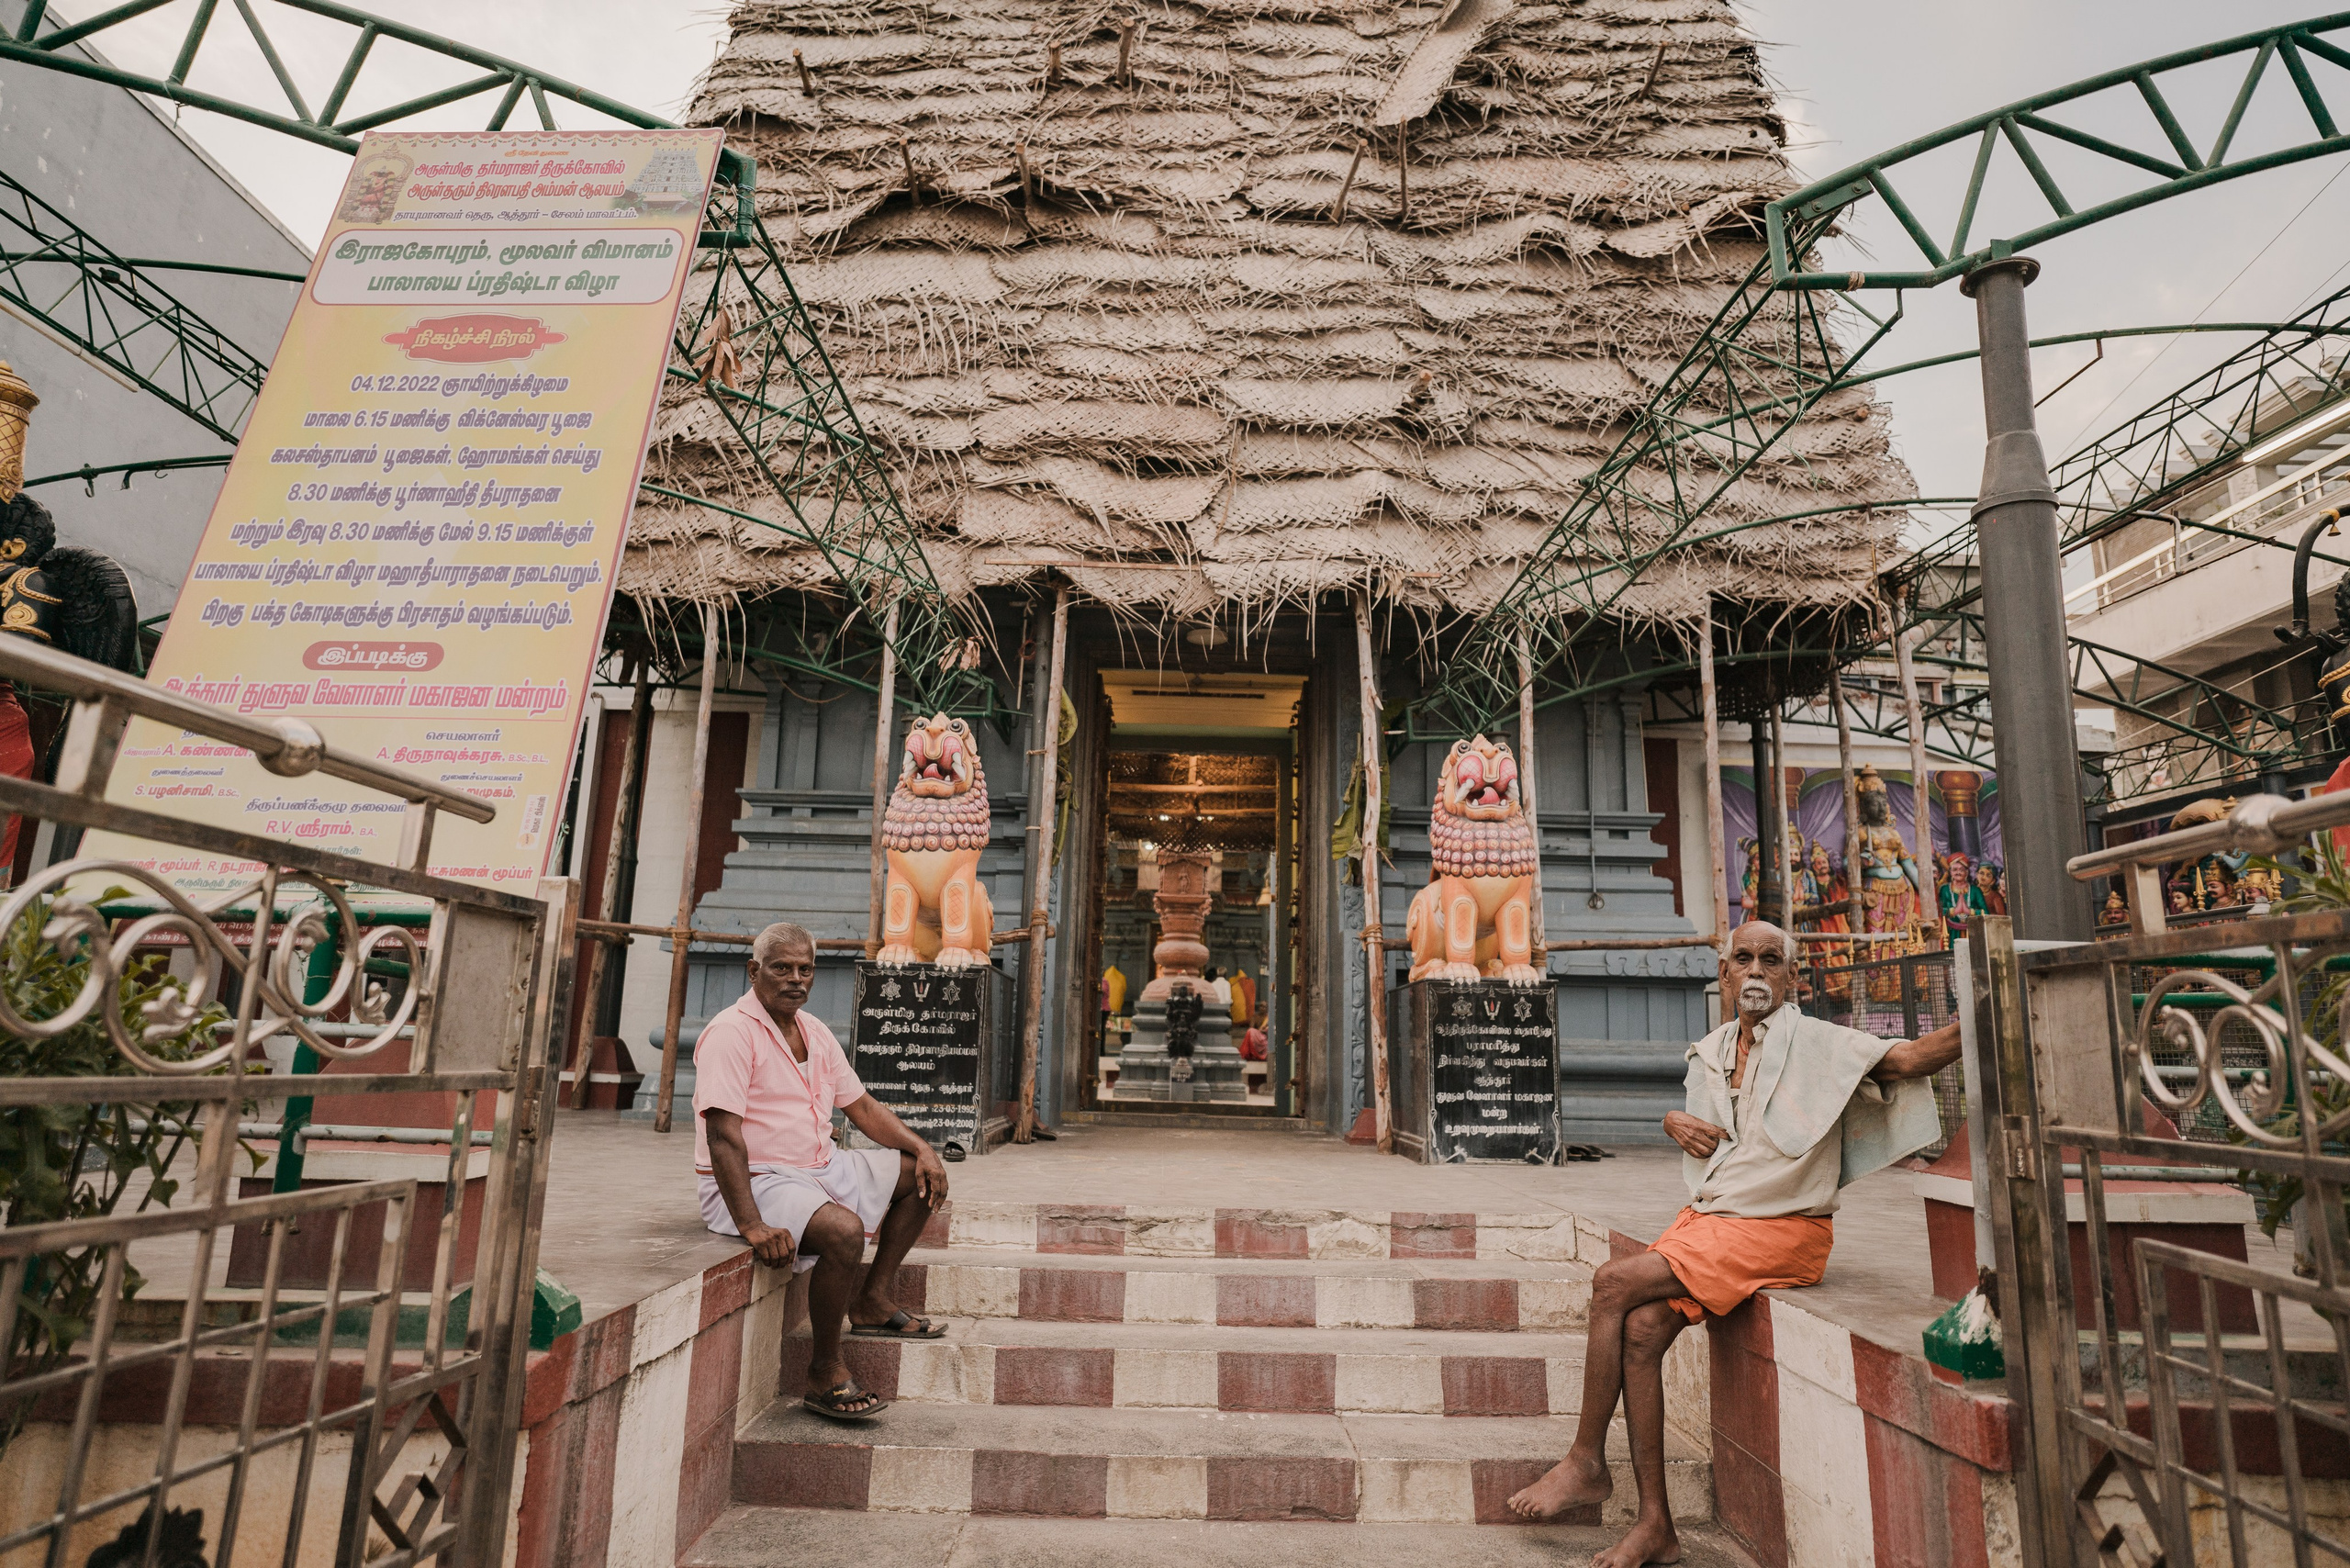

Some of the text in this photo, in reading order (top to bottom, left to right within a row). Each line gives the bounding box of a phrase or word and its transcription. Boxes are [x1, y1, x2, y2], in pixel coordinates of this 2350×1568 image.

[415, 159, 626, 178] அருள்மிகு தர்மராஜர் திருக்கோவில்
[407, 181, 475, 200] அருள்தரும்
[532, 182, 576, 200] அம்மன்
[578, 181, 625, 200] ஆலயம்
[394, 209, 462, 221] தாயுமானவர்
[465, 210, 494, 221] தெரு,
[498, 209, 540, 221] ஆத்தூர்
[551, 209, 583, 219] சேலம்
[586, 208, 637, 218] மாவட்டம்.
[335, 237, 673, 265] இராஜகோபுரம், மூலவர் விமானம்
[367, 270, 620, 297] பாலாலய ப்ரதிஷ்டா விழா
[413, 327, 536, 350] நிகழ்ச்சி நிரல்
[351, 374, 568, 398] 04.12.2022 ஞாயிற்றுக்கிழமை
[304, 409, 592, 435] மாலை 6.15 மணிக்கு விக்னேஸ்வர பூஜை
[271, 443, 601, 472] கலசஸ்தாபனம் பூஜைகள், ஹோமங்கள் செய்து
[287, 484, 327, 500] 8.30
[330, 481, 390, 504] மணிக்கு
[479, 479, 561, 508] தீபராதனை
[230, 519, 593, 547] மற்றும் இரவு 8.30 மணிக்கு மேல் 9.15 மணிக்குள்
[195, 558, 602, 591] பாலாலய ப்ரதிஷ்டா விழா மஹாதீபாராதனை நடைபெறும்.
[201, 599, 573, 630] பிறகு பக்த கோடிகளுக்கு பிரசாதம் வழங்கப்படும்.
[318, 645, 428, 668] இப்படிக்கு
[238, 683, 310, 713] துளுவ
[312, 678, 407, 708] வேளாளர்
[408, 684, 493, 708] மகாஜன
[495, 678, 567, 717] மன்றம்
[426, 729, 501, 741] செயலாளர்
[162, 744, 175, 756] A.
[376, 747, 390, 759] A.
[393, 746, 505, 764] திருநாவுக்கரசு,
[135, 786, 145, 795] S.
[149, 784, 214, 799] பழனிசாமி,
[245, 796, 347, 813] திருப்பணிக்குழு
[266, 821, 292, 834] R.V.
[492, 865, 532, 881] மூப்பர்
[862, 1005, 978, 1021] அருள்மிகு தர்மராஜர்
[857, 1041, 902, 1056] அருள்தரும்
[1466, 1039, 1520, 1053] பராமரித்து
[896, 1059, 935, 1071] ஆலயம்
[1494, 1056, 1548, 1068] வருபவர்கள்
[910, 1081, 934, 1094] தெரு,
[939, 1082, 974, 1094] ஆத்தூர்
[1473, 1073, 1512, 1087] ஆத்தூர்
[1436, 1090, 1553, 1103] துளுவ வேளாளர் மகாஜன
[1482, 1106, 1507, 1120] மன்ற
